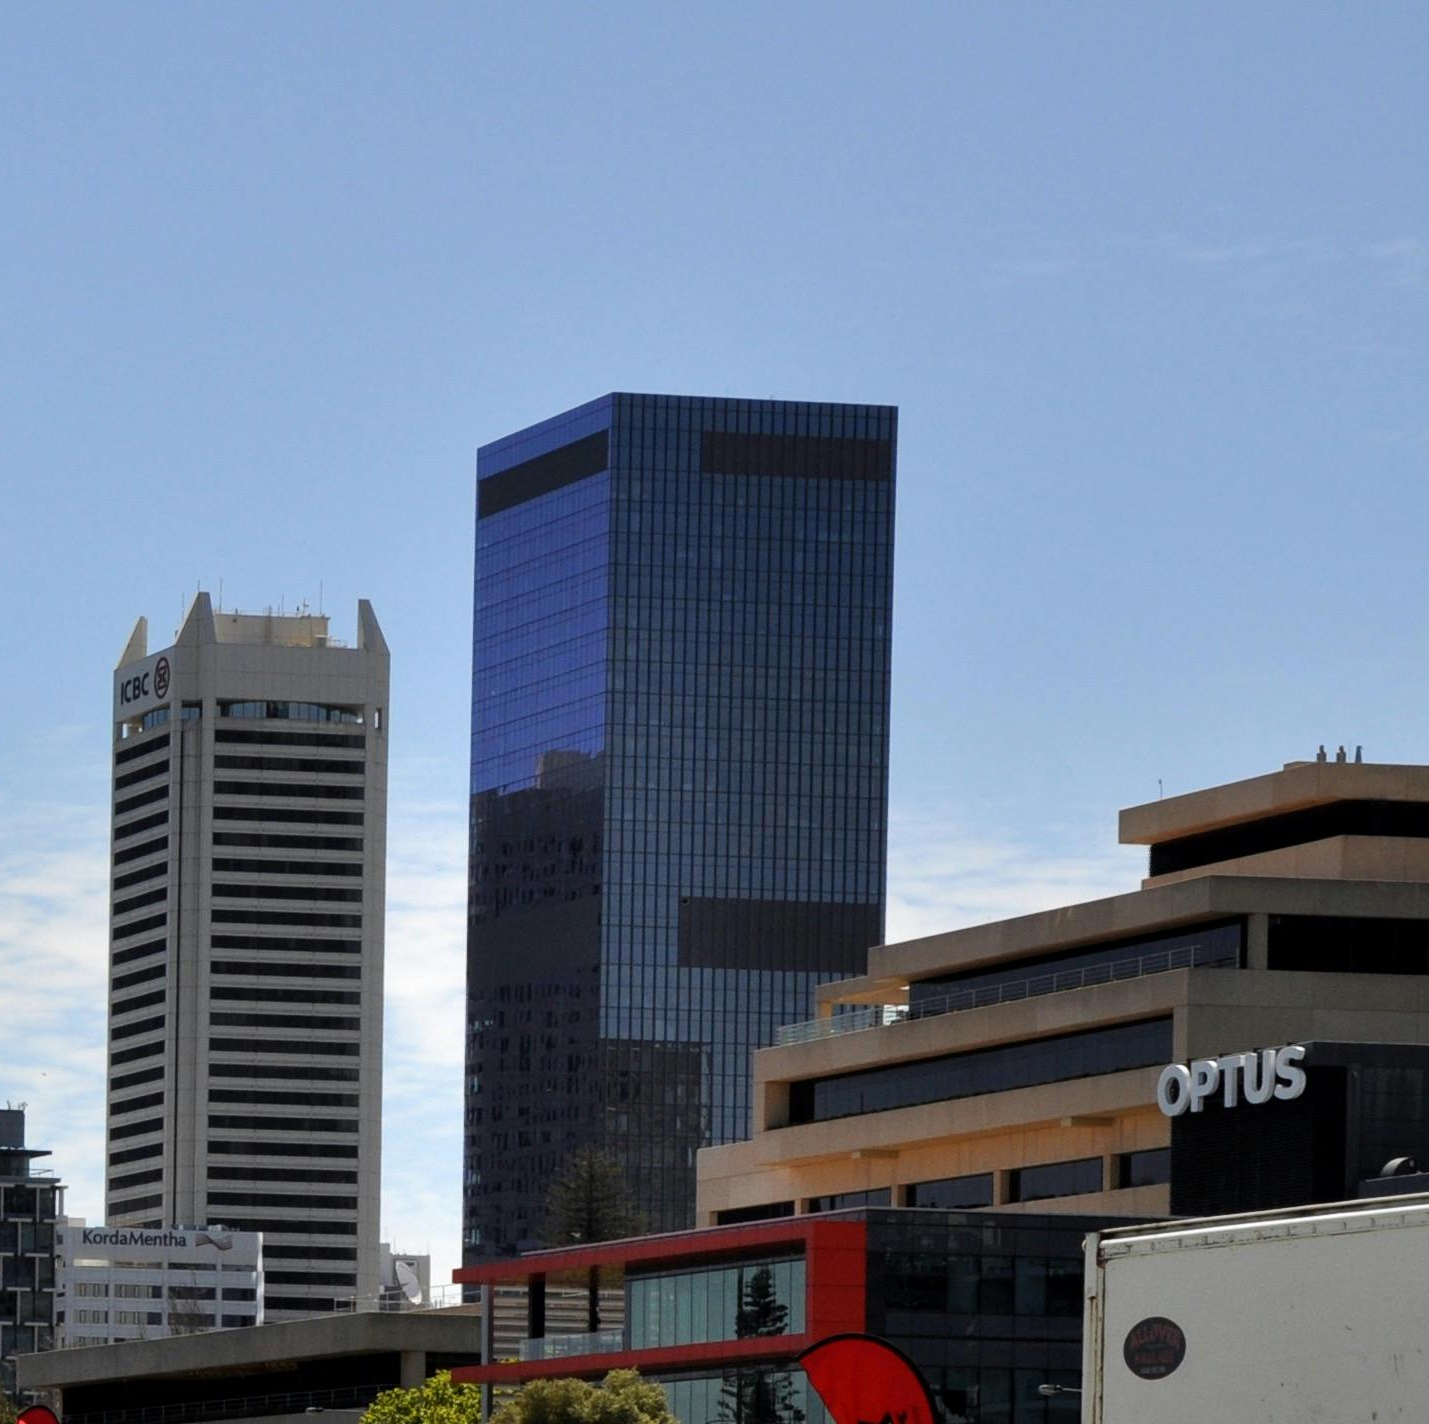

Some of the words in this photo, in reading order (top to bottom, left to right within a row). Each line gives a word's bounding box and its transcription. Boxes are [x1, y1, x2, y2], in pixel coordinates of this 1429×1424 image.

[121, 672, 149, 705] ICBC
[1157, 1046, 1307, 1117] OPTUS
[82, 1229, 187, 1248] KordaMentha
